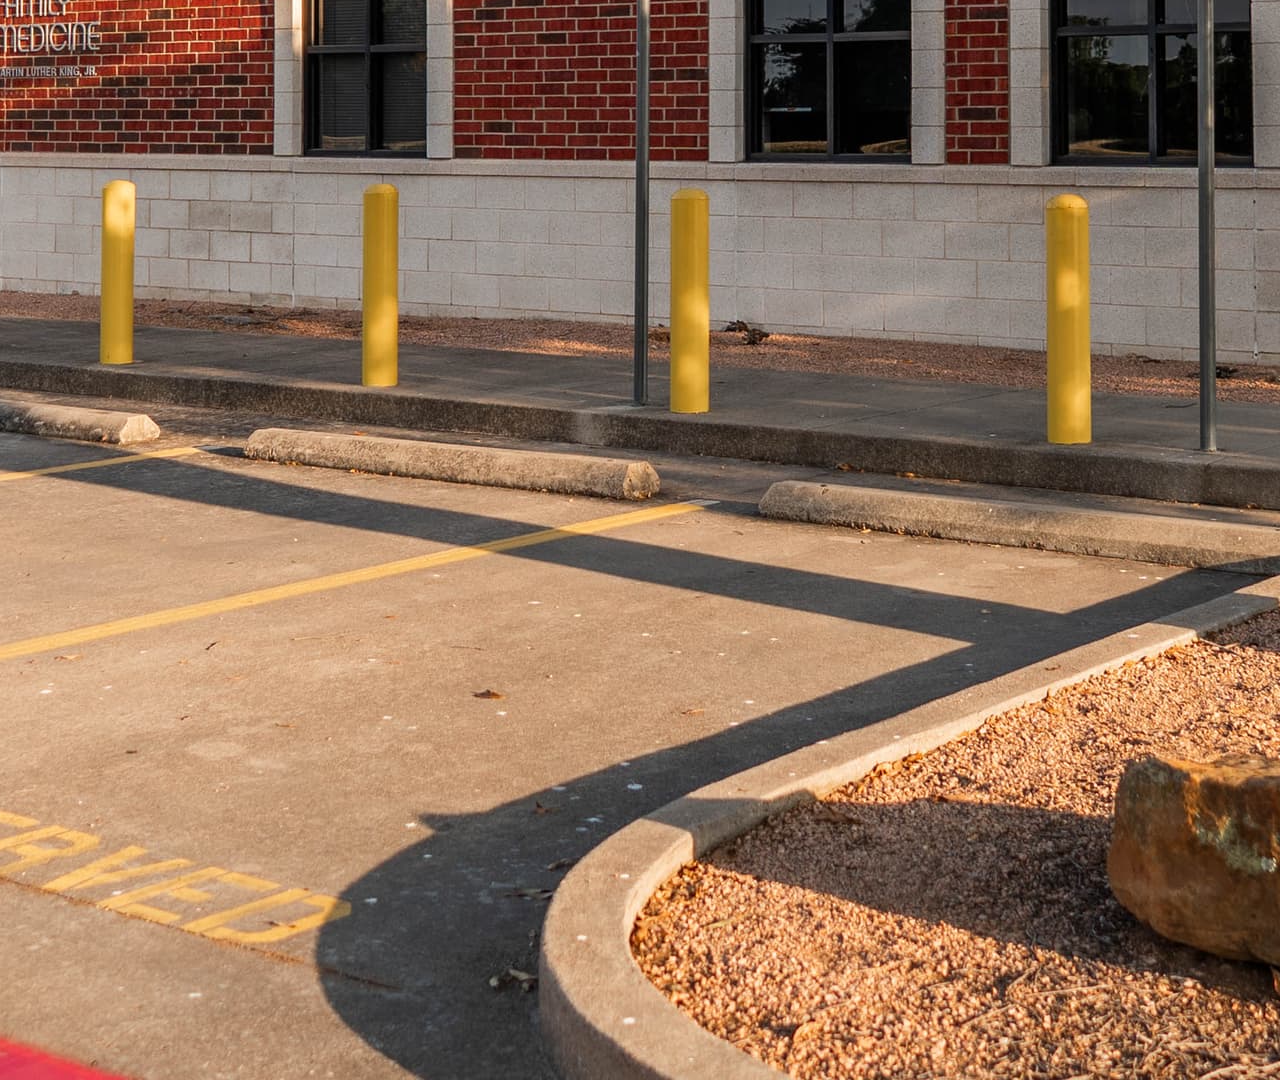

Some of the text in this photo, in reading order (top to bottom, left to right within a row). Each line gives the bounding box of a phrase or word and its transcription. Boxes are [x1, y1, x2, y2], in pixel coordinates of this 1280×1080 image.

[26, 66, 57, 77] LUTHER
[59, 65, 82, 77] KING,
[84, 65, 98, 76] JR.
